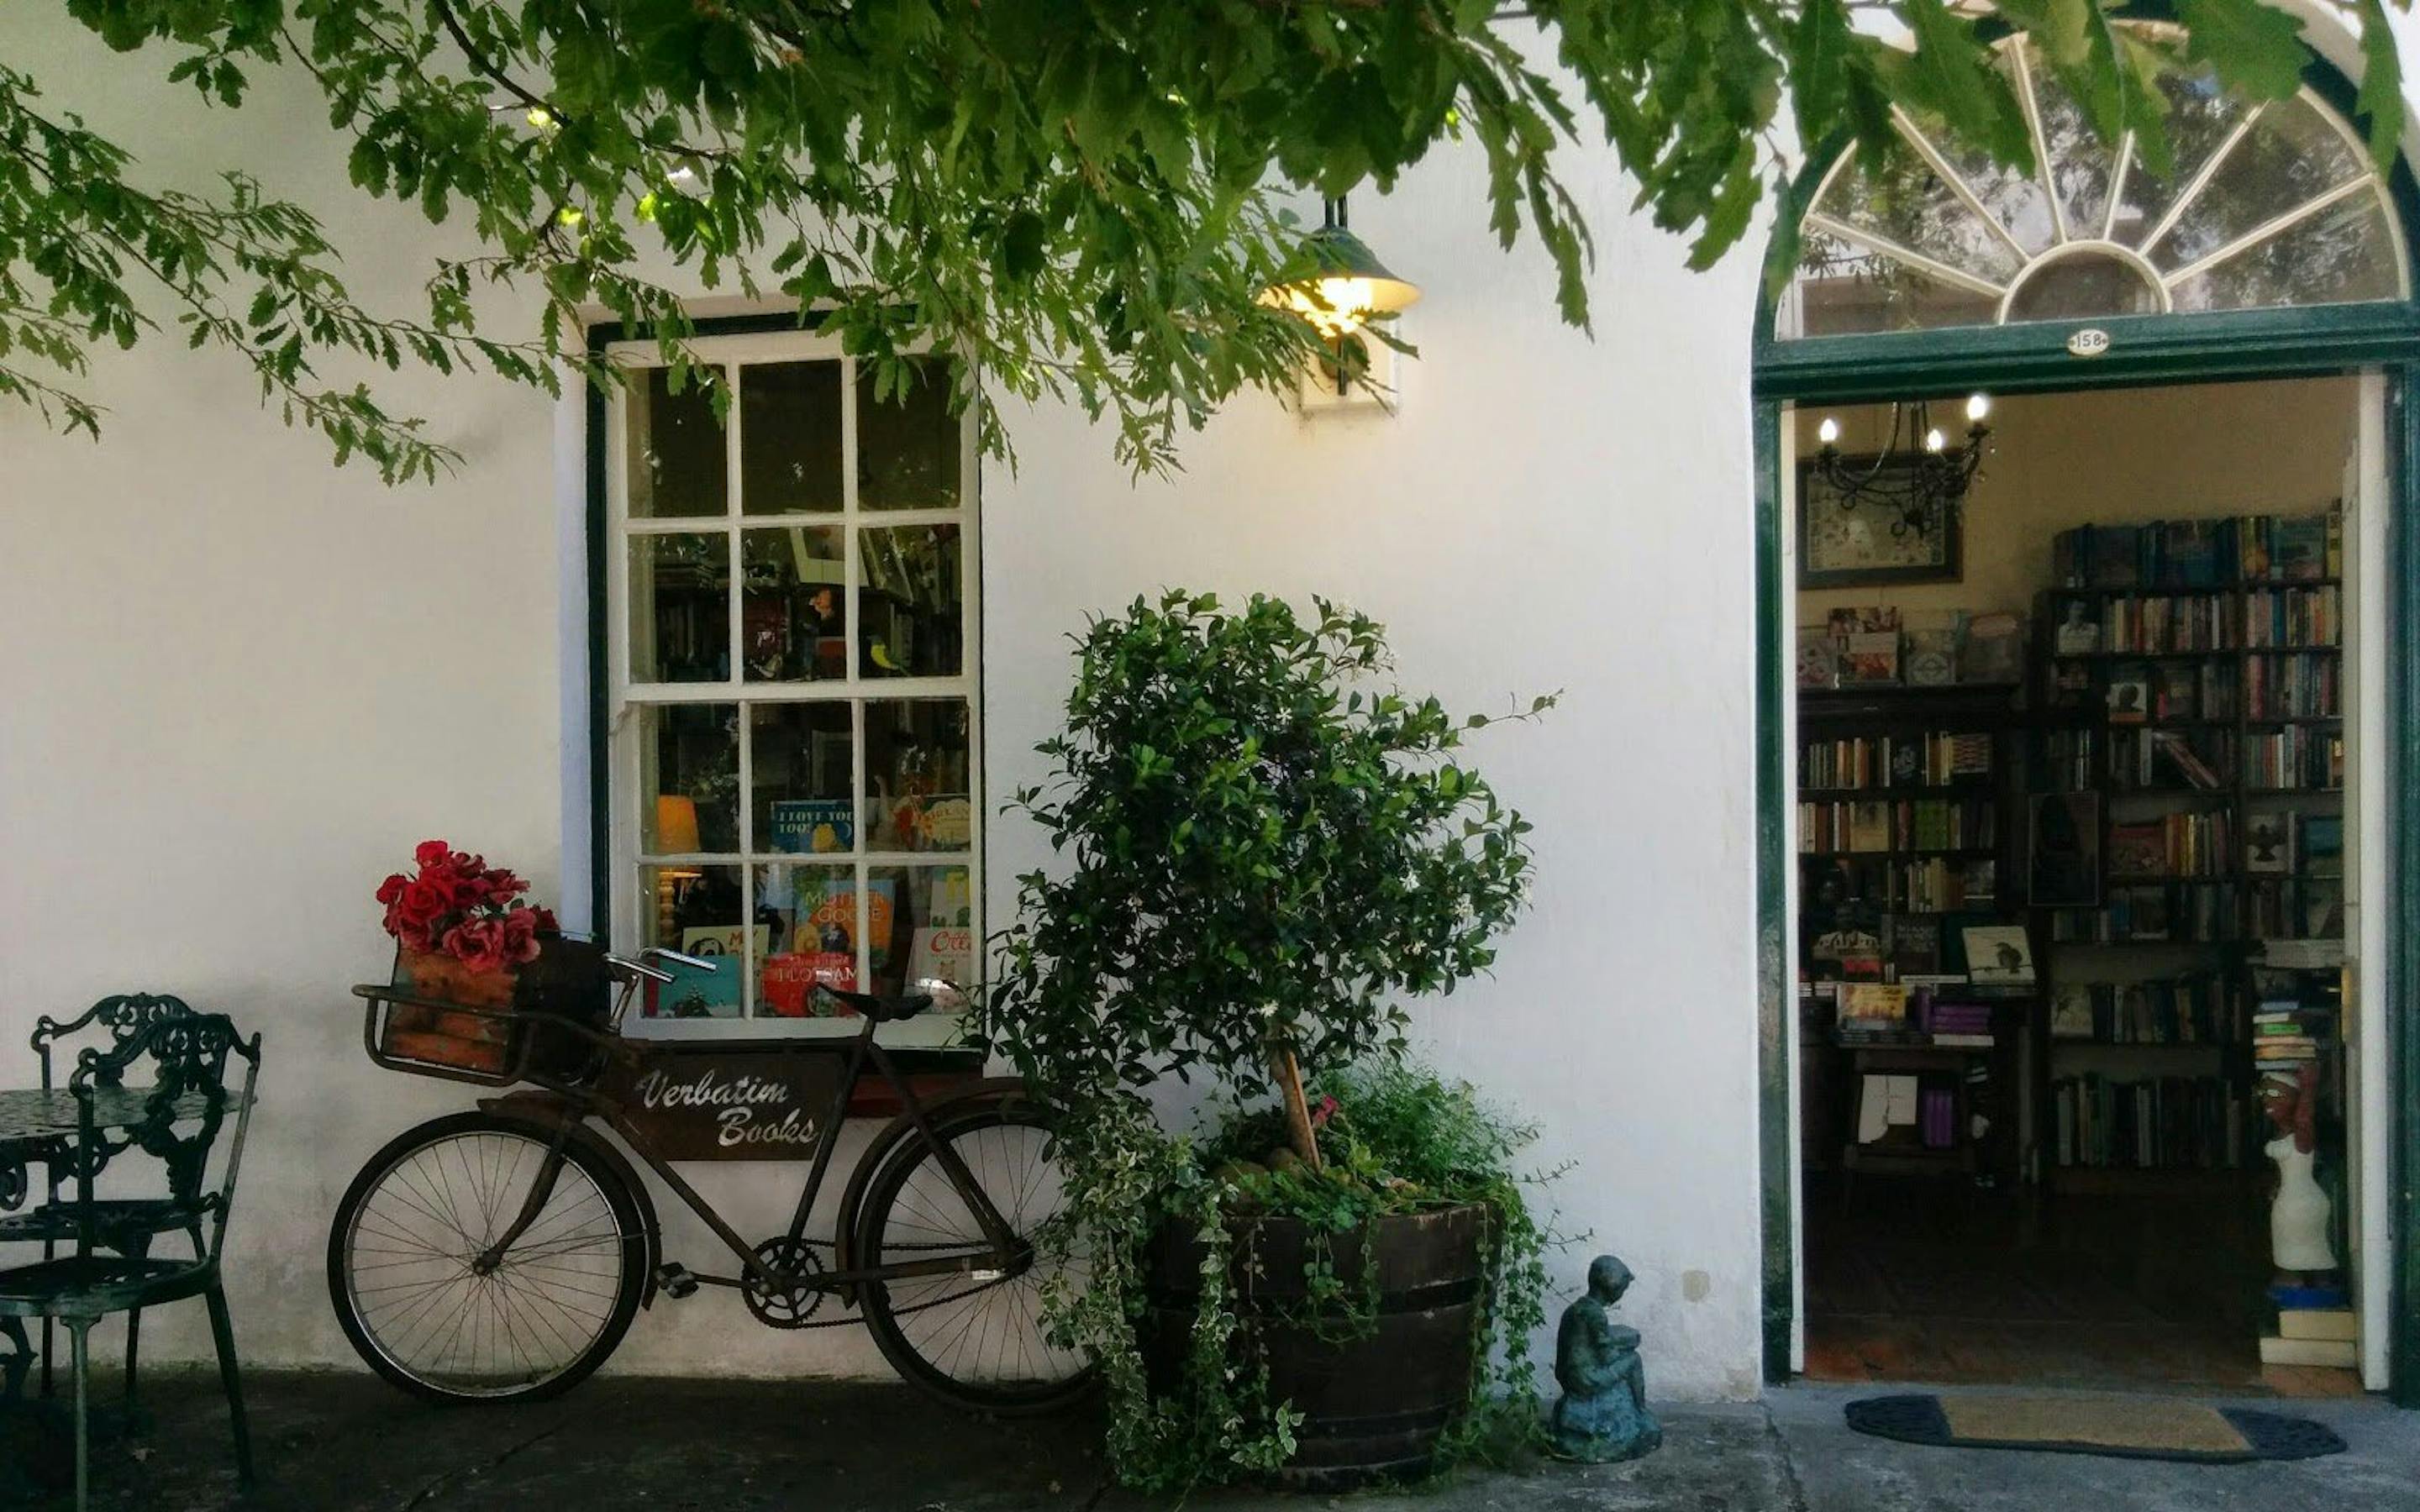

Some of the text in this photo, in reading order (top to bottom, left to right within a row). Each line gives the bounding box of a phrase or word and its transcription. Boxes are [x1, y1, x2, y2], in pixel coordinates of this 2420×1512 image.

[2076, 333, 2102, 348] 158
[787, 811, 823, 822] LOVE
[634, 1068, 788, 1109] Verbatim
[717, 1105, 819, 1147] Books
